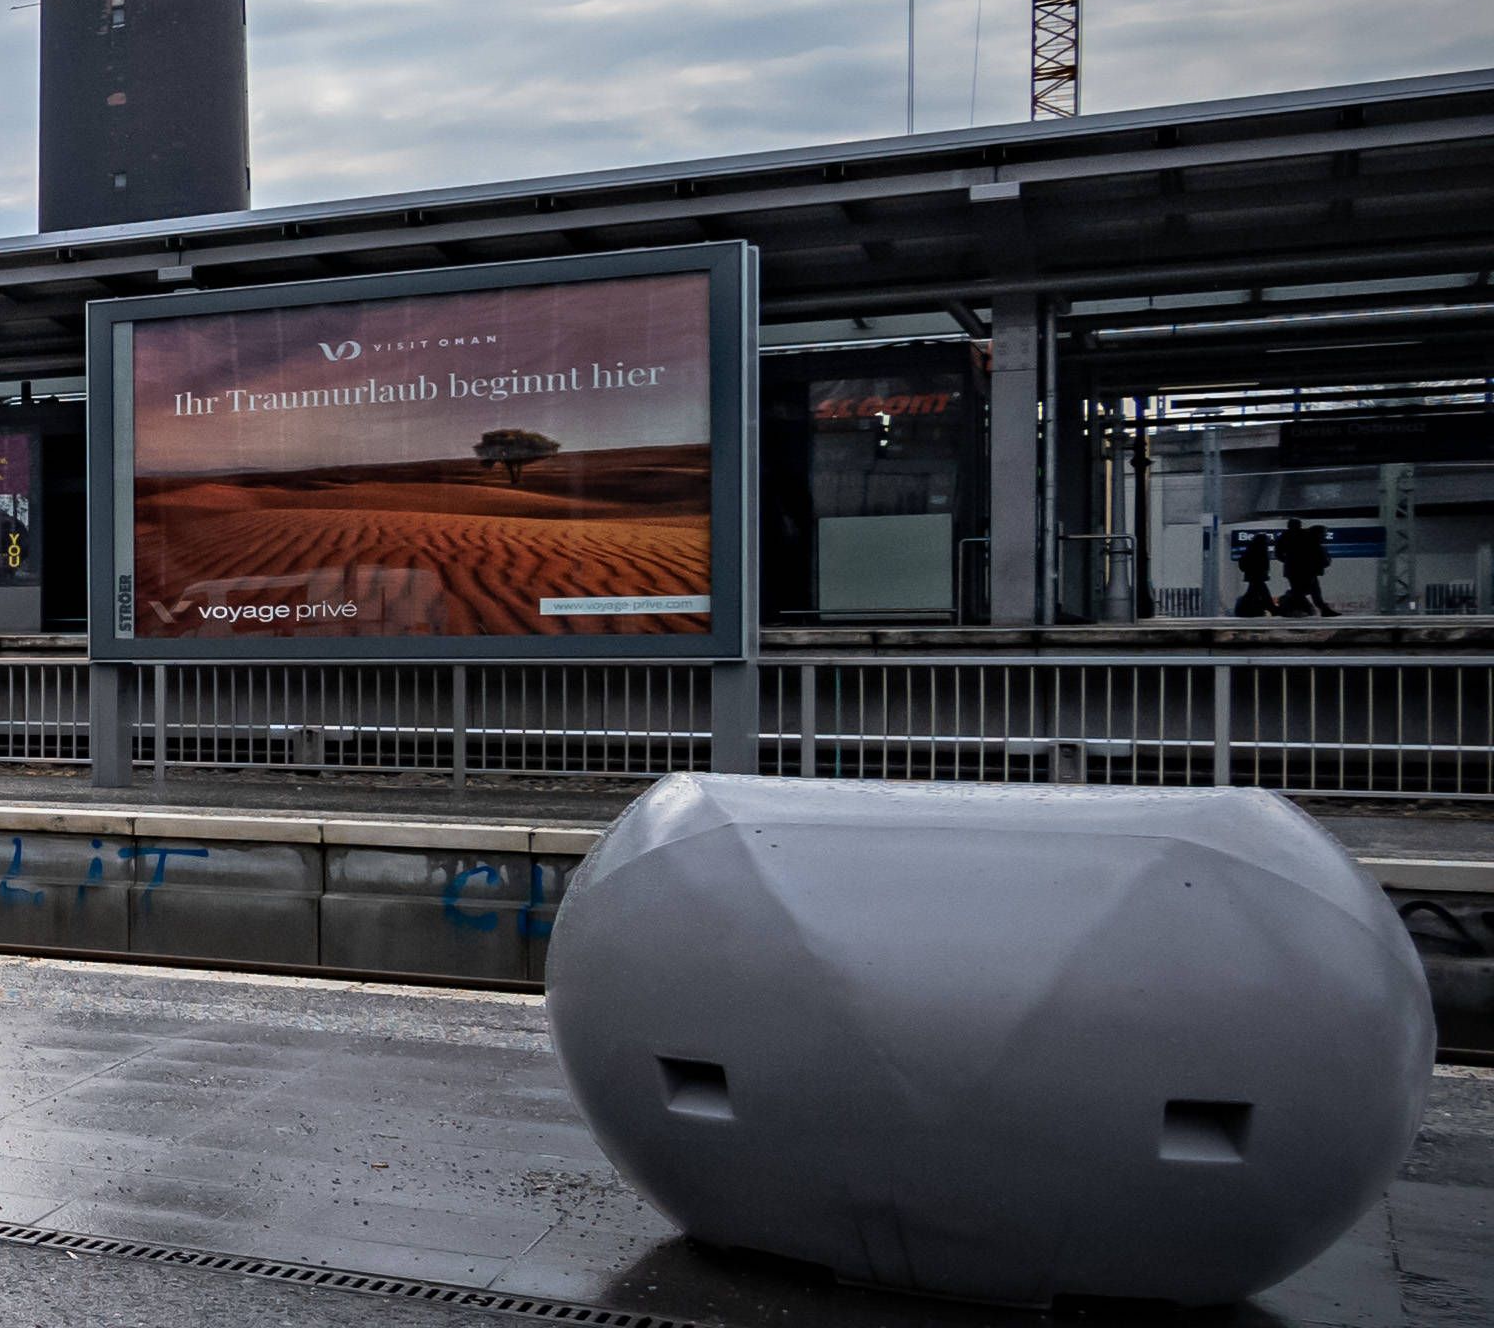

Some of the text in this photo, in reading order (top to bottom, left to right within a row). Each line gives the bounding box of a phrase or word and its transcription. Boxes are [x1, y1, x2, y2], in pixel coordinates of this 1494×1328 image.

[373, 339, 429, 352] VISIT
[438, 335, 497, 346] OMAN
[173, 361, 666, 416] Ihr Traumurlaub beginnt hier
[8, 532, 21, 568] YOU
[119, 574, 132, 632] STRÖER
[198, 600, 358, 623] voyage privé
